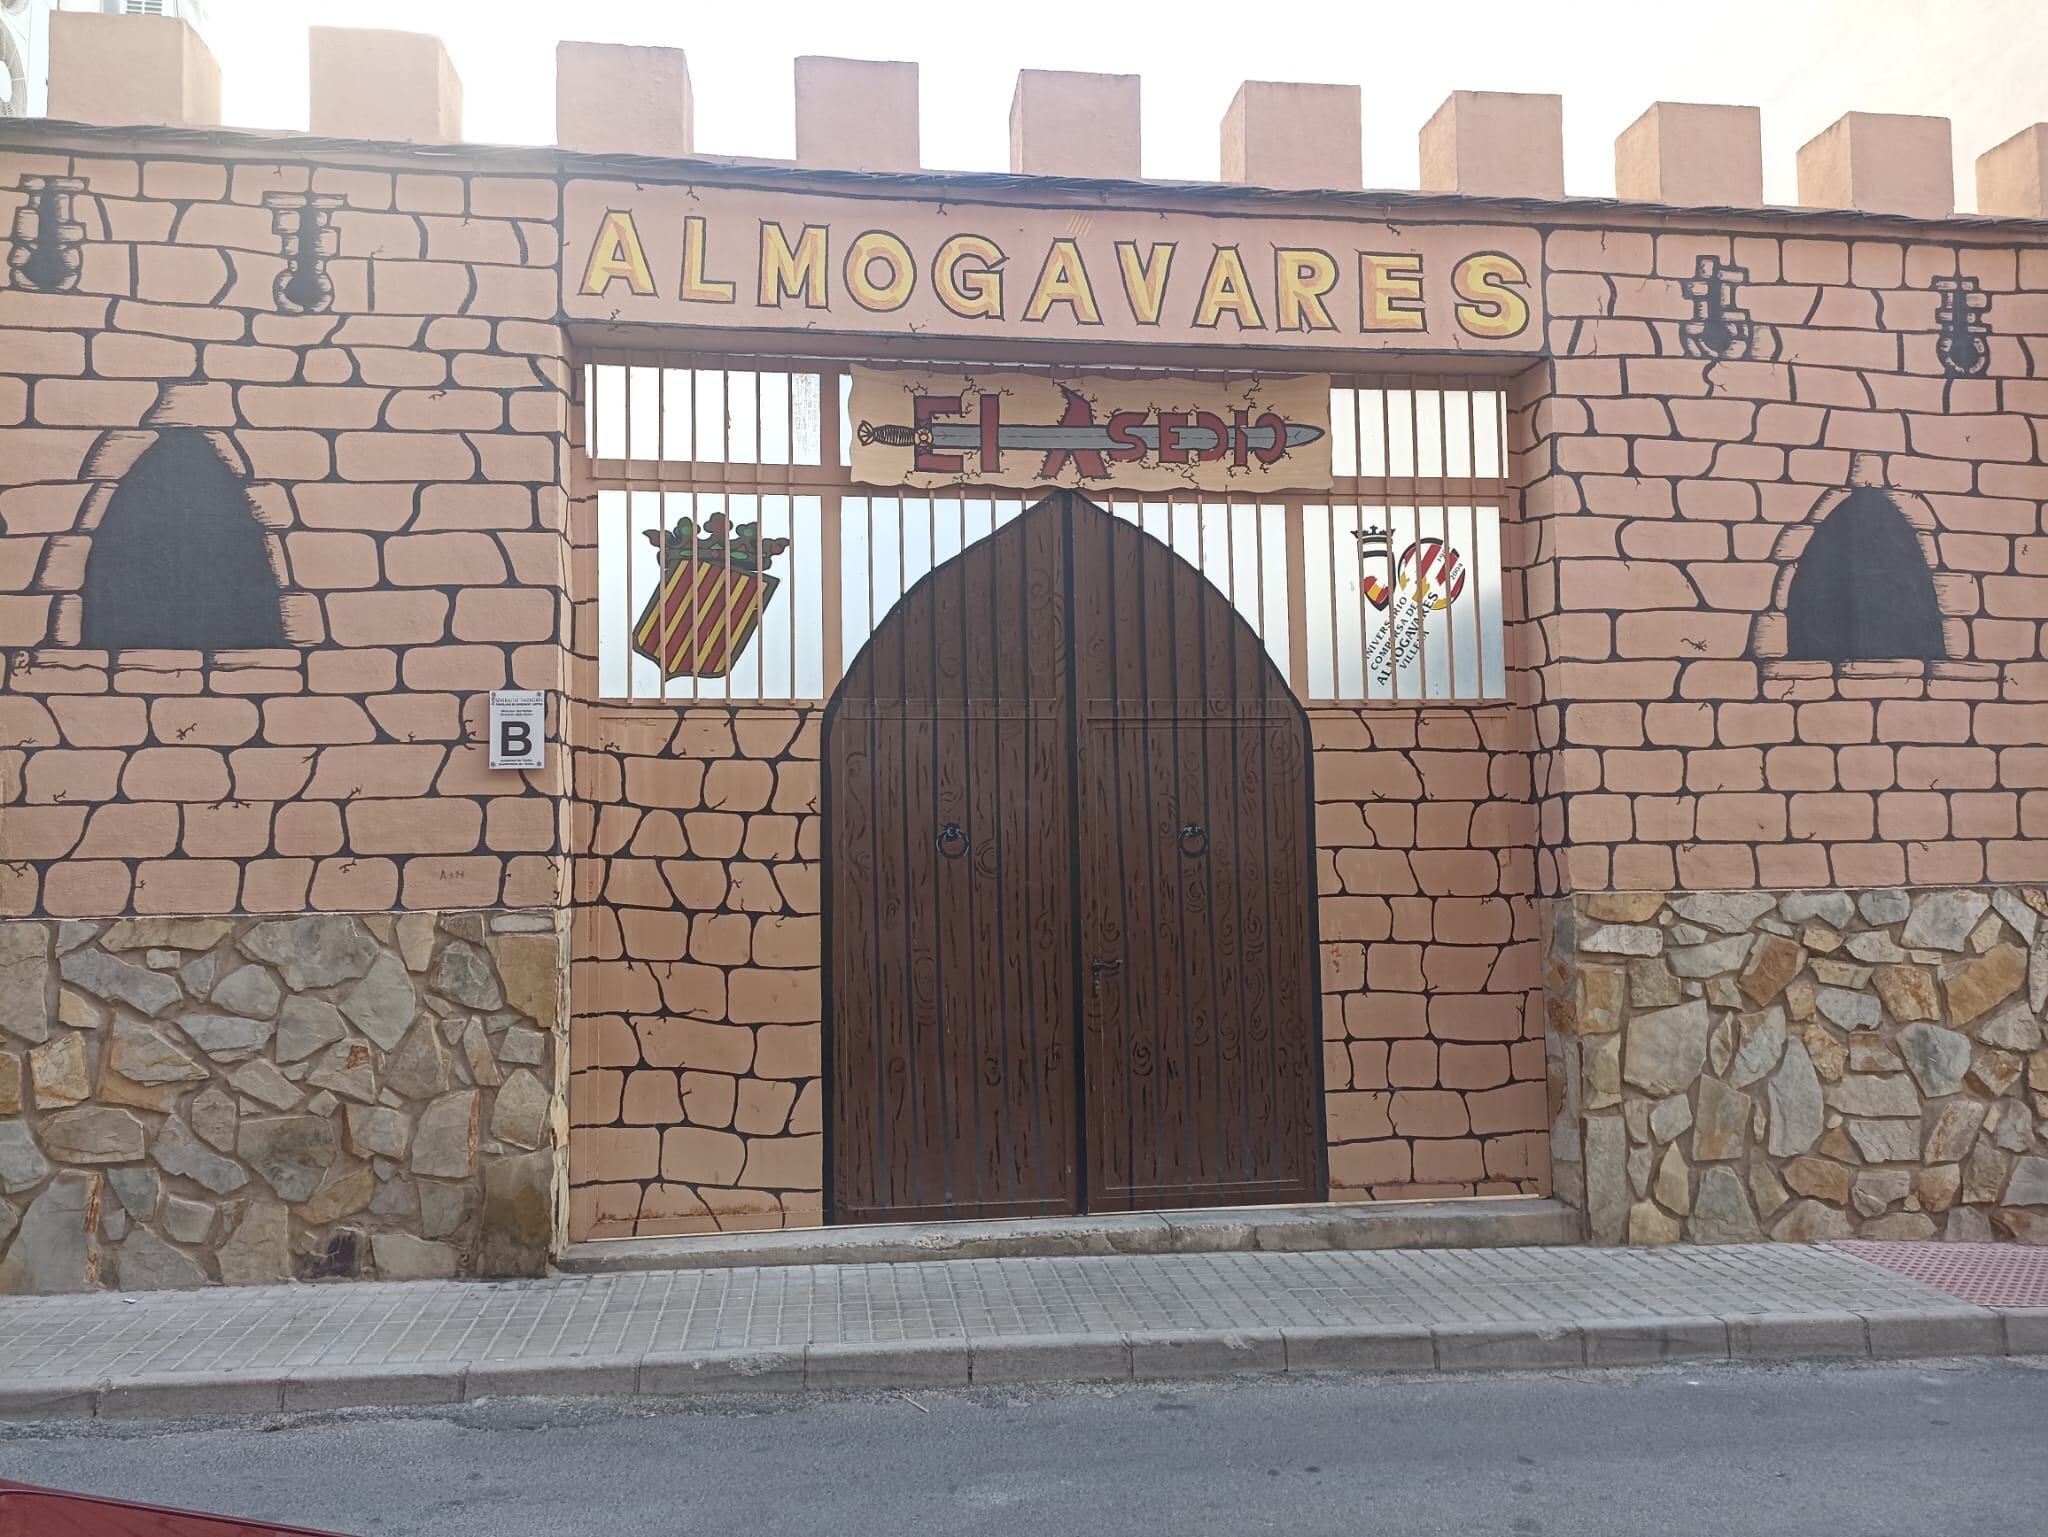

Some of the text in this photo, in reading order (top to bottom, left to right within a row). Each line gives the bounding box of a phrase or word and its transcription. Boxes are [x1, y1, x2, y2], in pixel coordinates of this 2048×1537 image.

[580, 209, 1531, 340] ALMOGAVARES
[1039, 382, 1289, 480] ASEDIO
[1364, 596, 1408, 661] NIVERSRIO
[1370, 602, 1418, 671] COMPRSA DE
[1399, 630, 1430, 670] VILLEA
[501, 721, 532, 756] B
